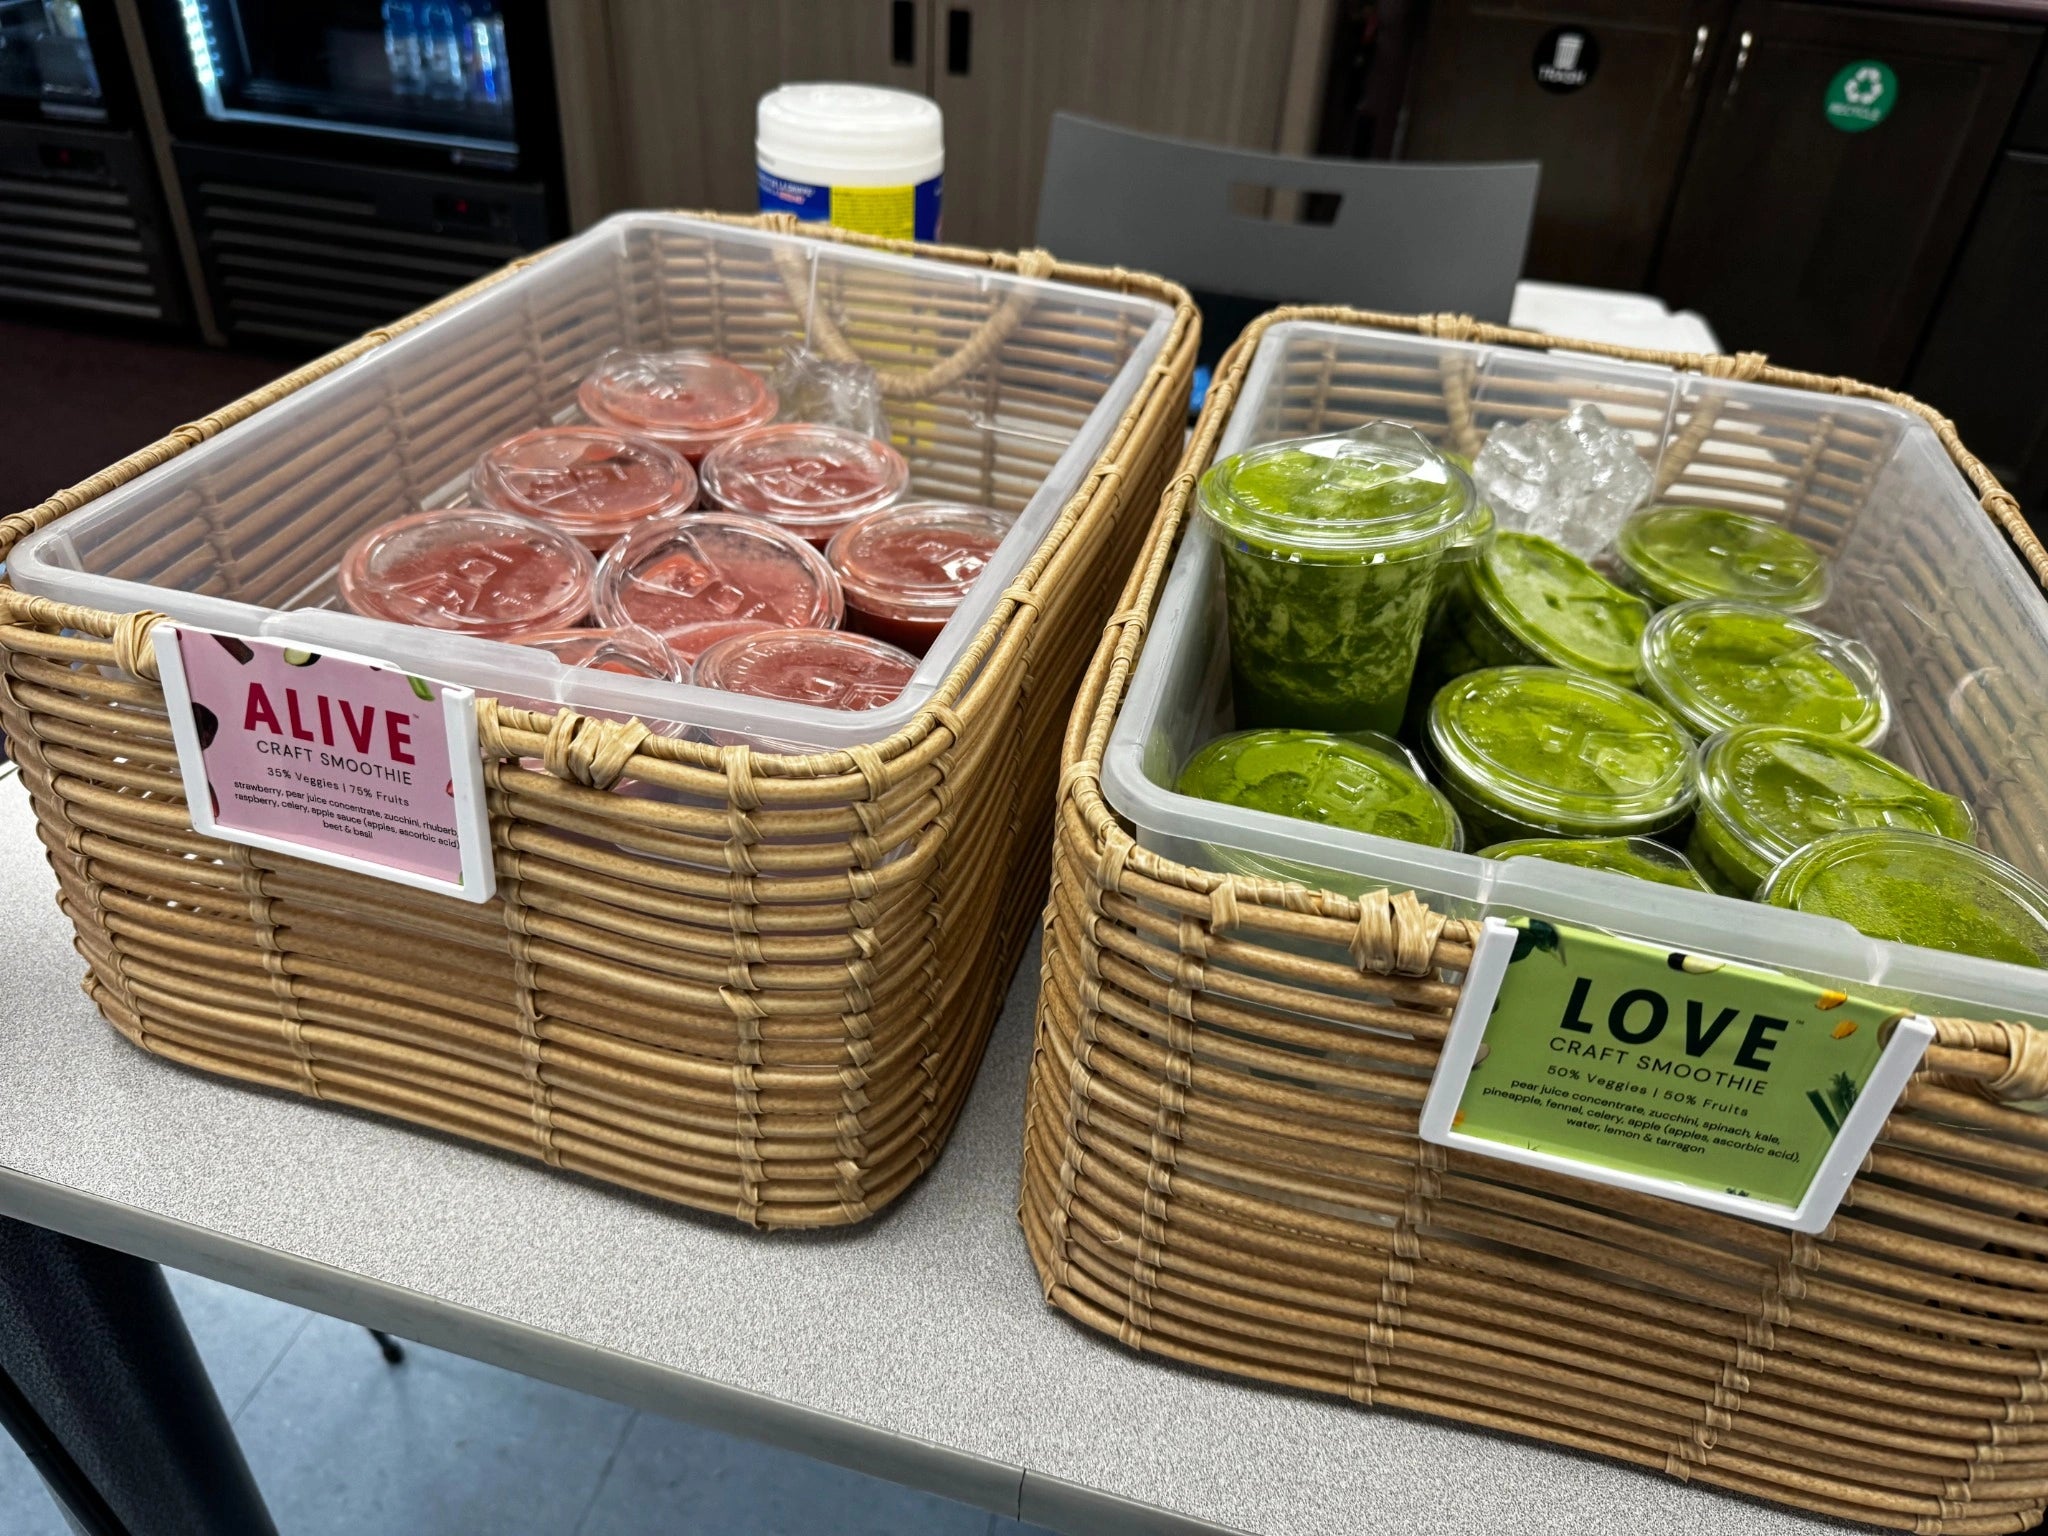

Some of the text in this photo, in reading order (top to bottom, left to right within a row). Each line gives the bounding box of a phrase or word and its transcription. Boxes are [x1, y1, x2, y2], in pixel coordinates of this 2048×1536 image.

[256, 740, 413, 786] CRAFT SMOOTHIE
[267, 767, 292, 780] 35%
[294, 771, 339, 789] Veggies
[350, 784, 373, 798] 75%
[376, 791, 410, 807] Fruits
[233, 780, 284, 797] strawberry,
[285, 789, 305, 799] pear
[306, 792, 327, 805] juice
[328, 799, 383, 819] concentrate,
[384, 812, 422, 828] zucchini,
[234, 793, 280, 808] raspberry,
[281, 800, 310, 814] celery,
[311, 807, 335, 818] apple
[336, 813, 362, 825] sauce
[363, 817, 398, 834] (apples,
[399, 828, 436, 843] ascorbic
[322, 820, 373, 839] beet & basil
[1547, 1065, 1581, 1080] 50%
[1587, 1072, 1648, 1095] Veggies
[1663, 1090, 1697, 1106] 50%
[1702, 1098, 1749, 1117] Fruits
[1549, 1037, 1769, 1096] CRAFT SMOOTHIE
[1482, 1086, 1543, 1107] pineapple,
[1545, 1098, 1584, 1116] fennel,
[1586, 1108, 1624, 1125] celery,
[1627, 1118, 1662, 1132] apple
[1663, 1123, 1710, 1143] (apples,
[1712, 1136, 1765, 1154] ascorbic
[1510, 1079, 1781, 1146] pear juice concentrate, zucchini, spinach, kale,
[1566, 1117, 1706, 1154] water, lemon & tarragon
